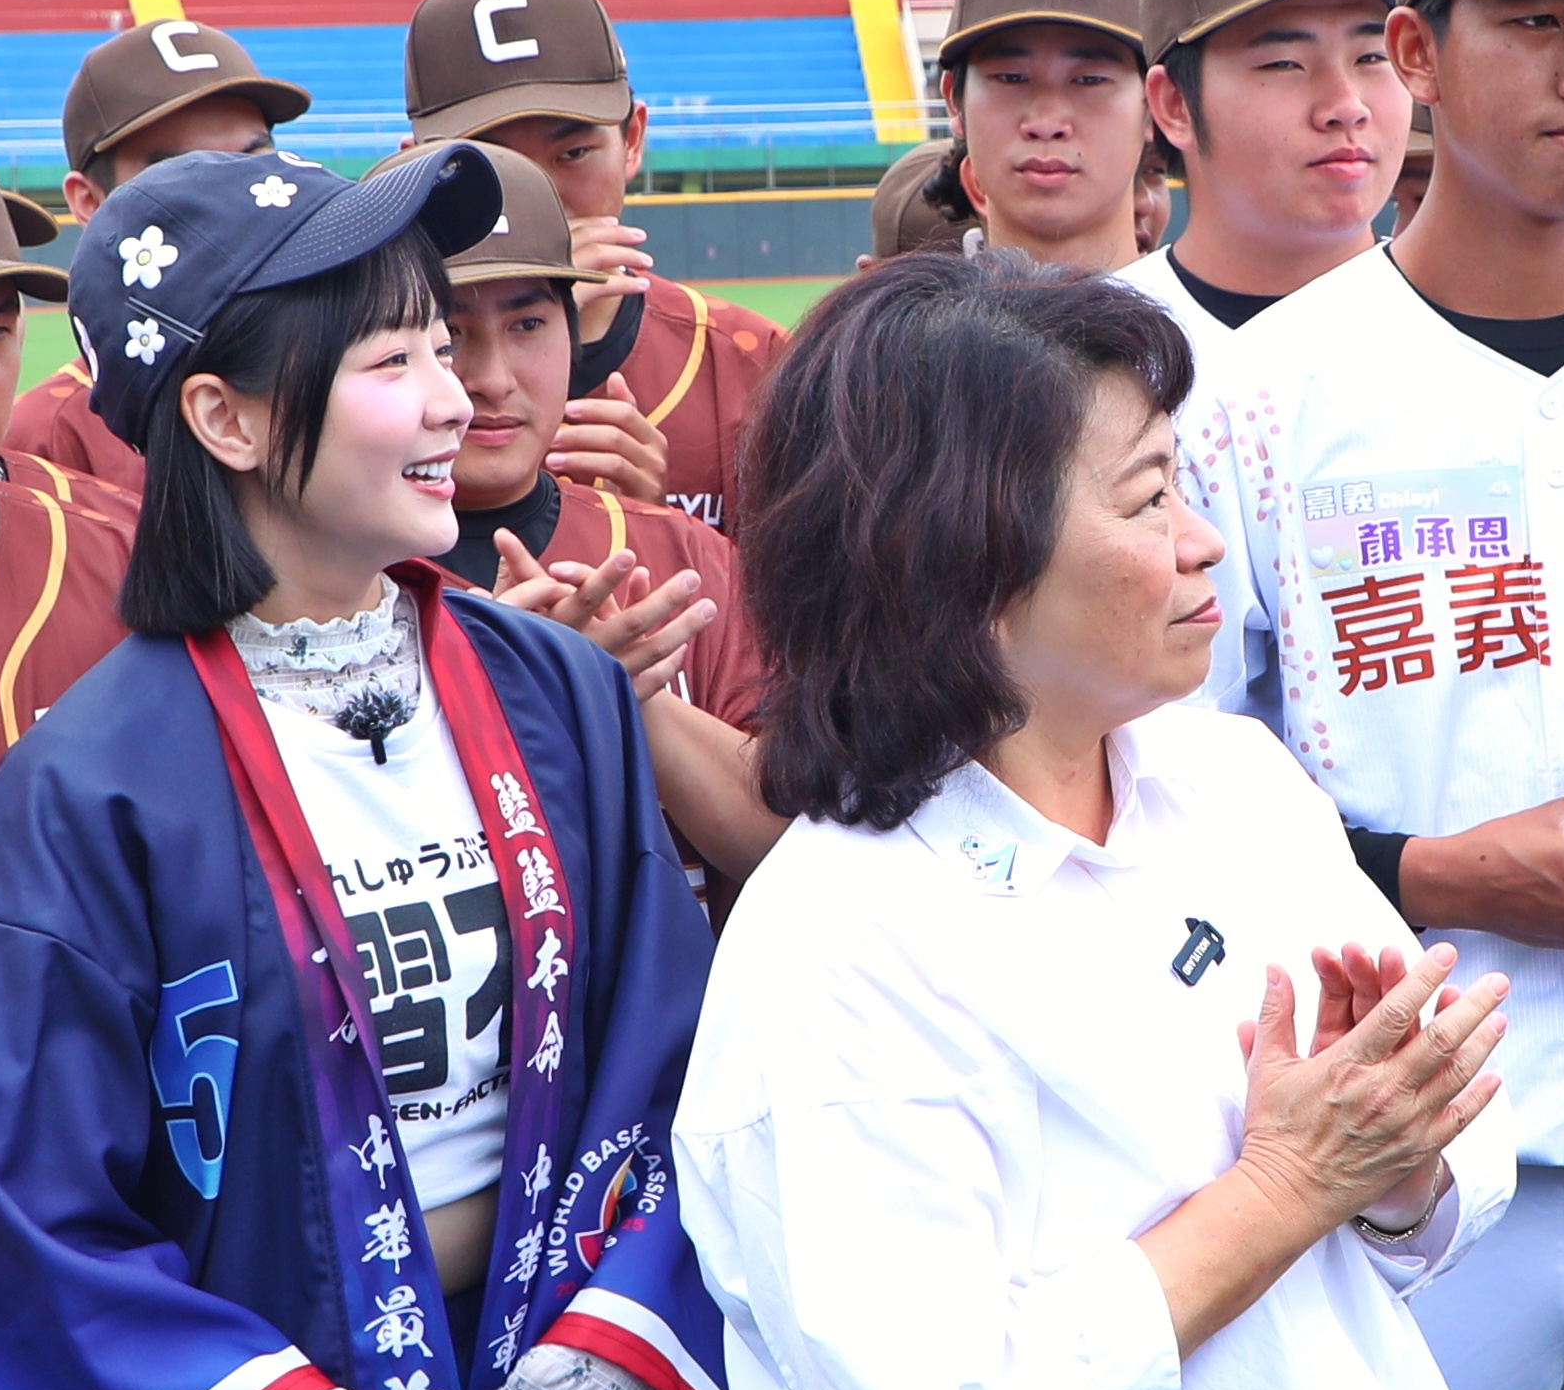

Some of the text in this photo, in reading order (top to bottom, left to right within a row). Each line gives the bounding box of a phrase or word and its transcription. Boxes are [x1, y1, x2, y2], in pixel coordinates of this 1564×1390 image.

[150, 20, 220, 73] C
[1302, 481, 1440, 521] 嘉義 Chiayi
[1357, 515, 1511, 567] 顏承恩
[546, 1171, 585, 1278] WORLD
[634, 1135, 668, 1214] LASSIC
